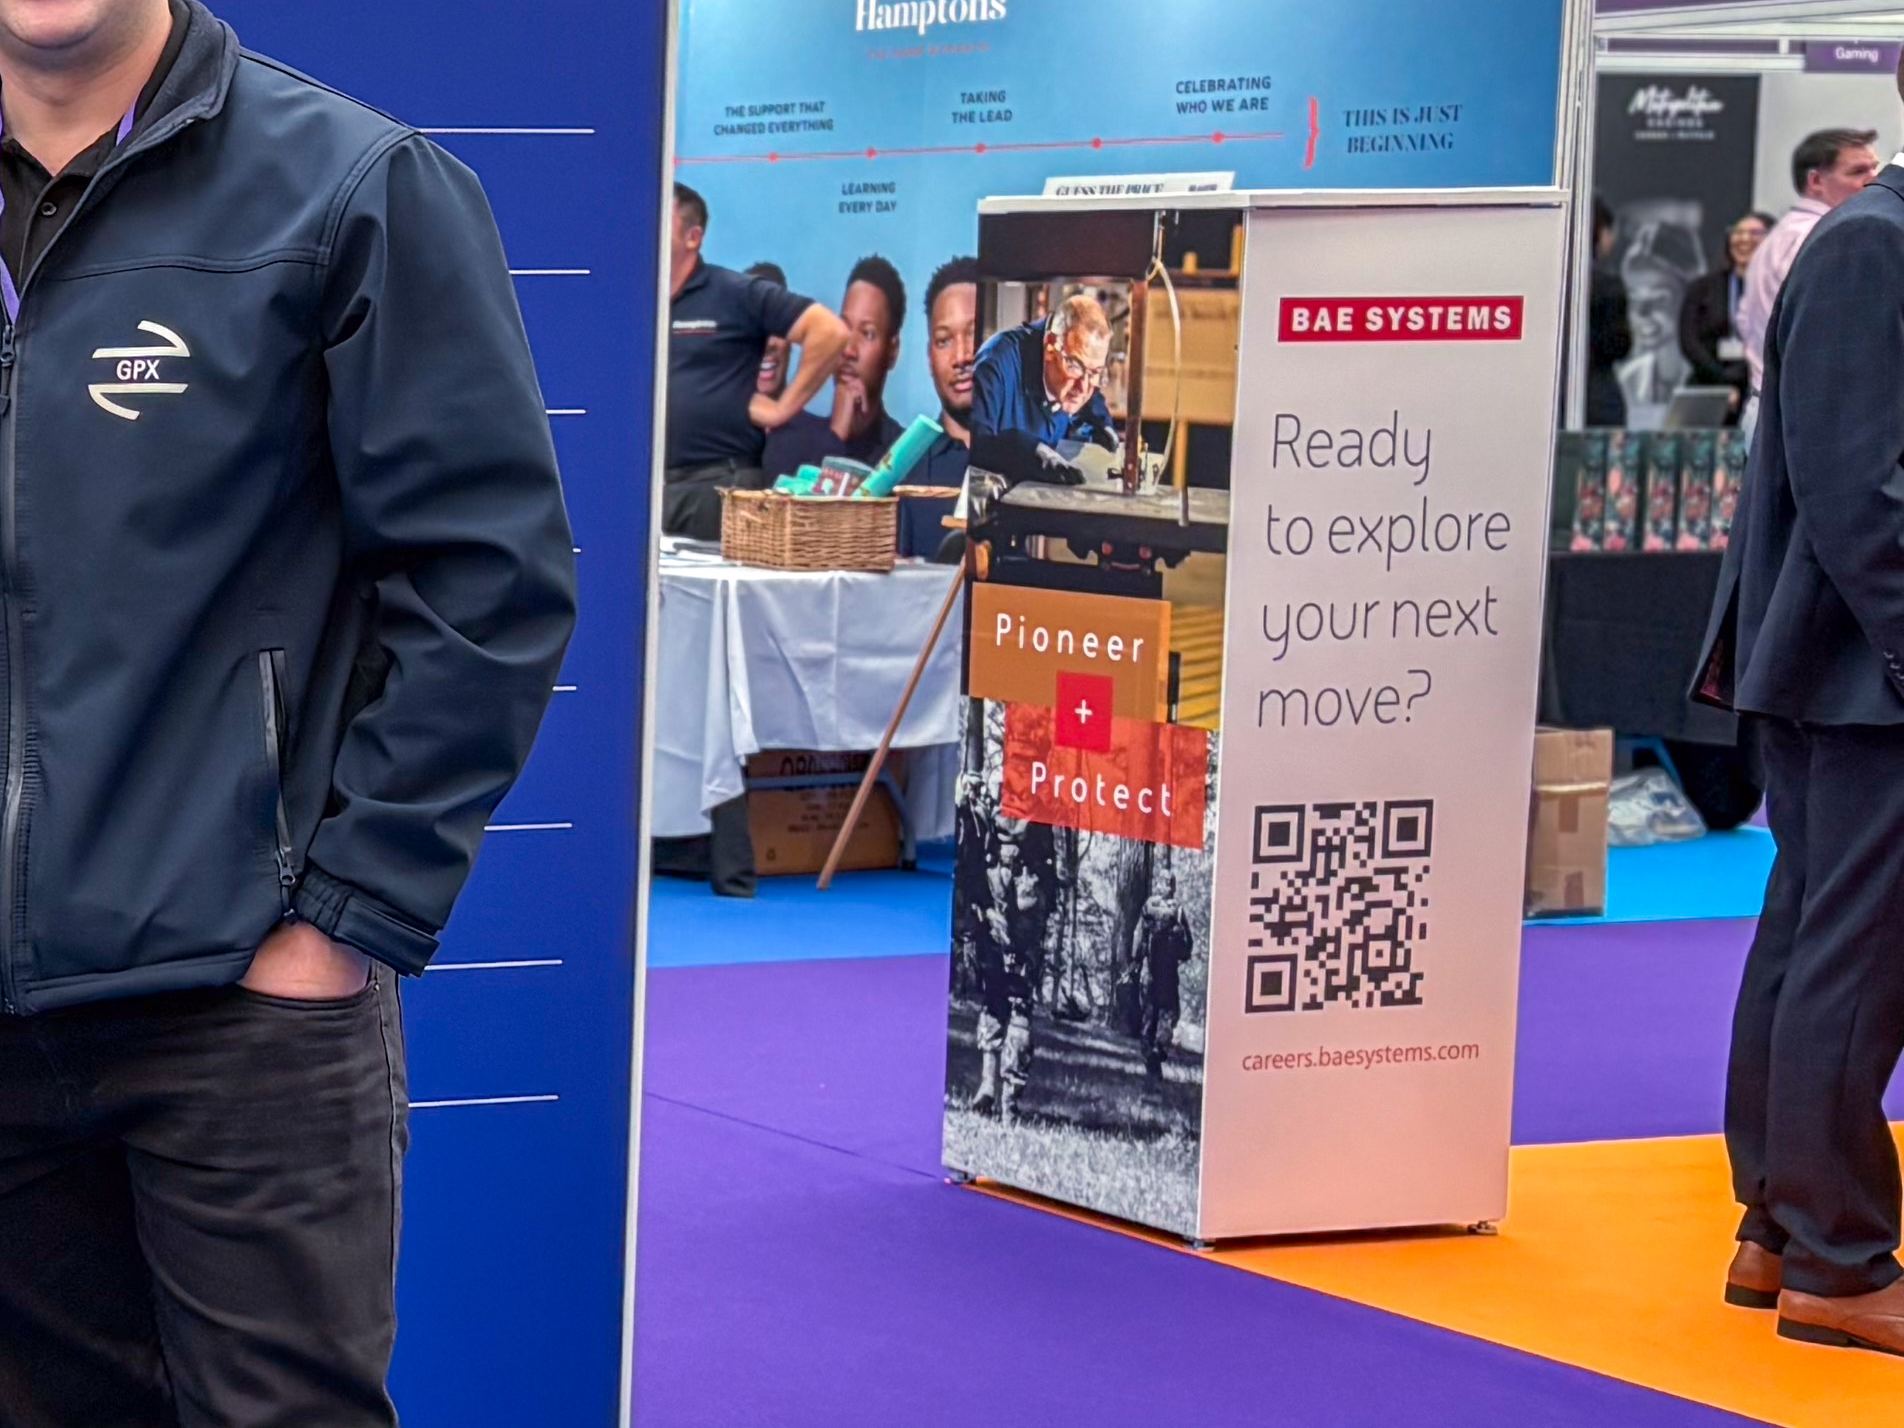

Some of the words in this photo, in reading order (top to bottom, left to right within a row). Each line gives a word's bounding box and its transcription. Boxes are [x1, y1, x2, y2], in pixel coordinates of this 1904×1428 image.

[1835, 47, 1879, 62] Gaming
[1175, 75, 1271, 94] CELEBRATING
[960, 90, 1007, 104] TAKING
[1175, 99, 1208, 114] WHO
[1211, 99, 1235, 113] WE
[1239, 97, 1269, 111] ARE
[725, 105, 746, 117] THE
[748, 102, 796, 117] SUPPORT
[799, 101, 826, 114] THAT
[951, 111, 976, 124] THE
[979, 110, 1013, 122] LEAD
[1342, 108, 1386, 128] THIS
[1392, 107, 1410, 124] IS
[1413, 104, 1463, 123] JUST
[714, 122, 766, 136] CHANGED
[768, 119, 834, 134] EVERYTHING
[1346, 132, 1454, 154] BEGINNING
[842, 181, 896, 195] LEARNING
[839, 201, 873, 214] EVERY
[875, 200, 897, 213] DAY
[1290, 308, 1354, 333] BAE
[1365, 305, 1513, 332] SYSTEMS
[116, 360, 160, 380] GPX
[1272, 410, 1434, 485] Ready
[1267, 504, 1313, 557] to
[1327, 498, 1512, 575] explore
[1262, 593, 1378, 665] your
[1392, 584, 1500, 639] next
[995, 612, 1145, 664] Pioneer
[1258, 668, 1434, 728] move?
[1030, 760, 1174, 817] Protect
[1242, 1038, 1481, 1076] careers.baesystems.com
